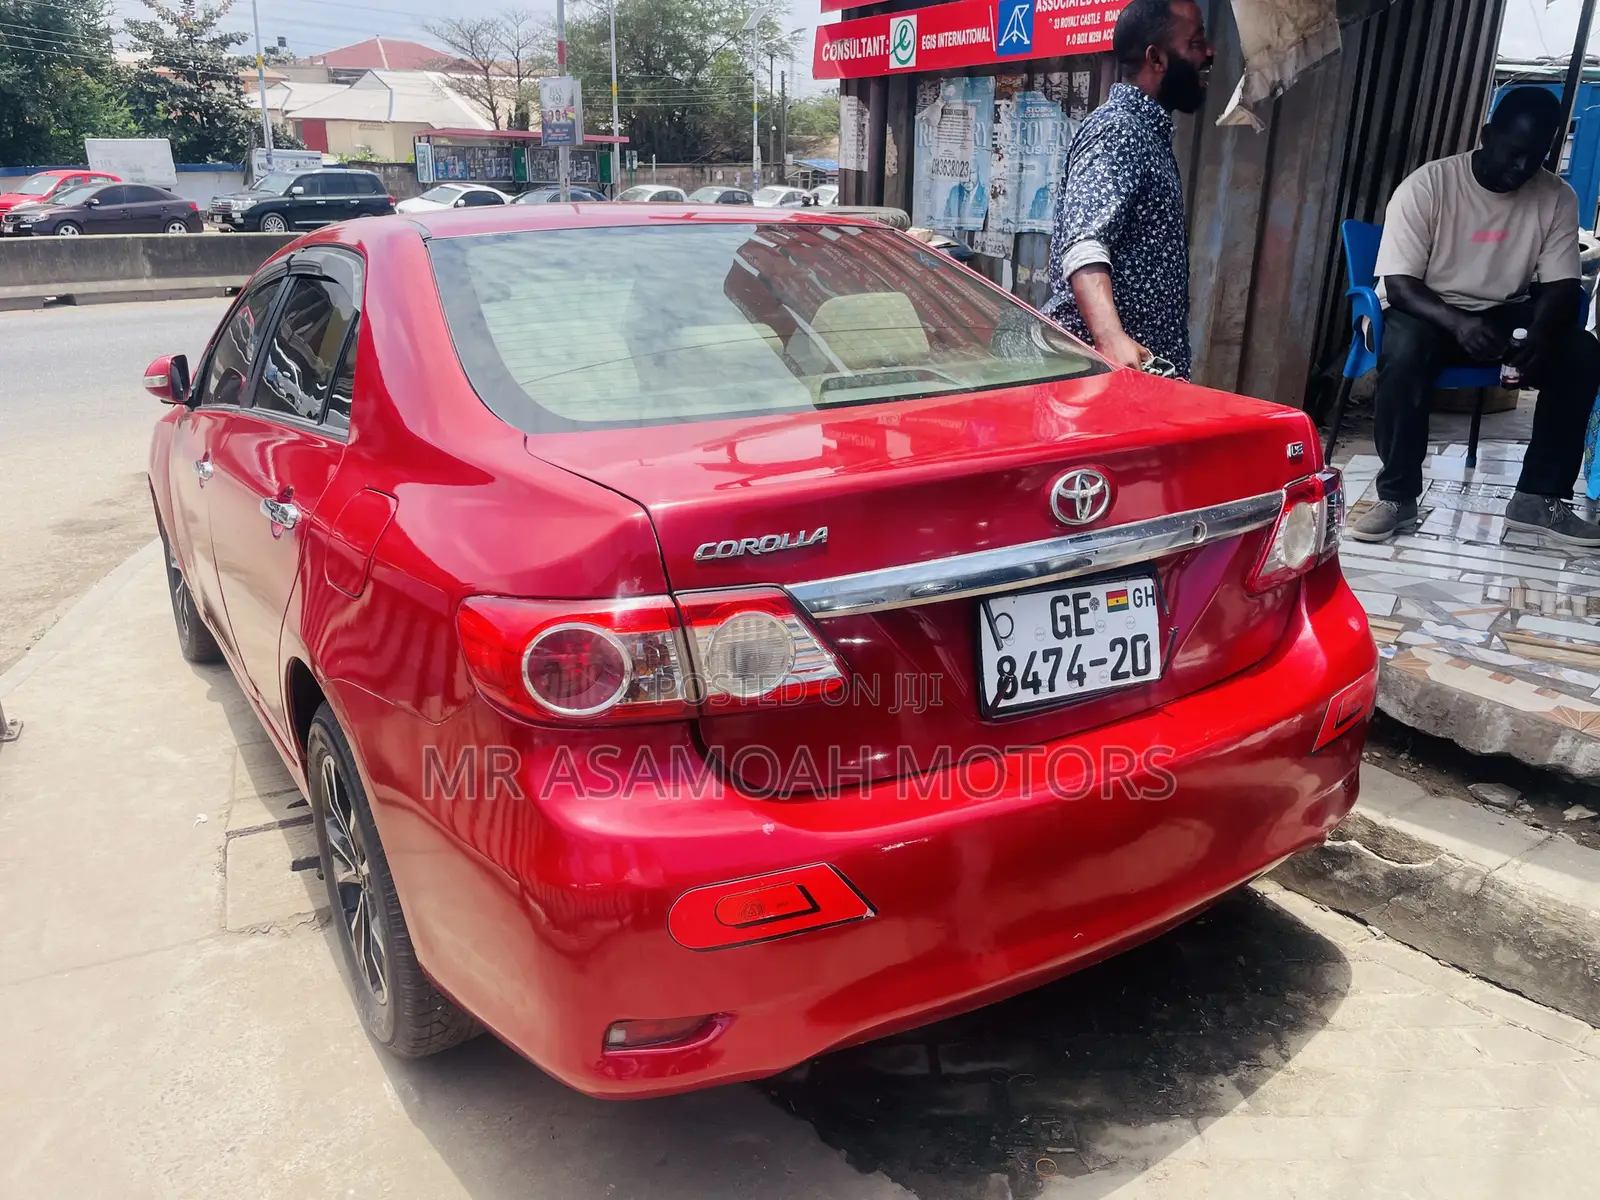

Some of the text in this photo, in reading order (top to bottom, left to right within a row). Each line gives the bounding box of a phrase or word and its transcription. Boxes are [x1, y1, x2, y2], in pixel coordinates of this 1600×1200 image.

[1080, 12, 1101, 26] CASTLE
[822, 35, 889, 62] CONSULTANT:
[921, 27, 991, 50] EGIS INTERNATIONAL
[1004, 120, 1078, 148] ECOVERY
[693, 526, 829, 561] COROLLA
[1050, 585, 1155, 640] GE GH
[997, 633, 1151, 700] 8474-20
